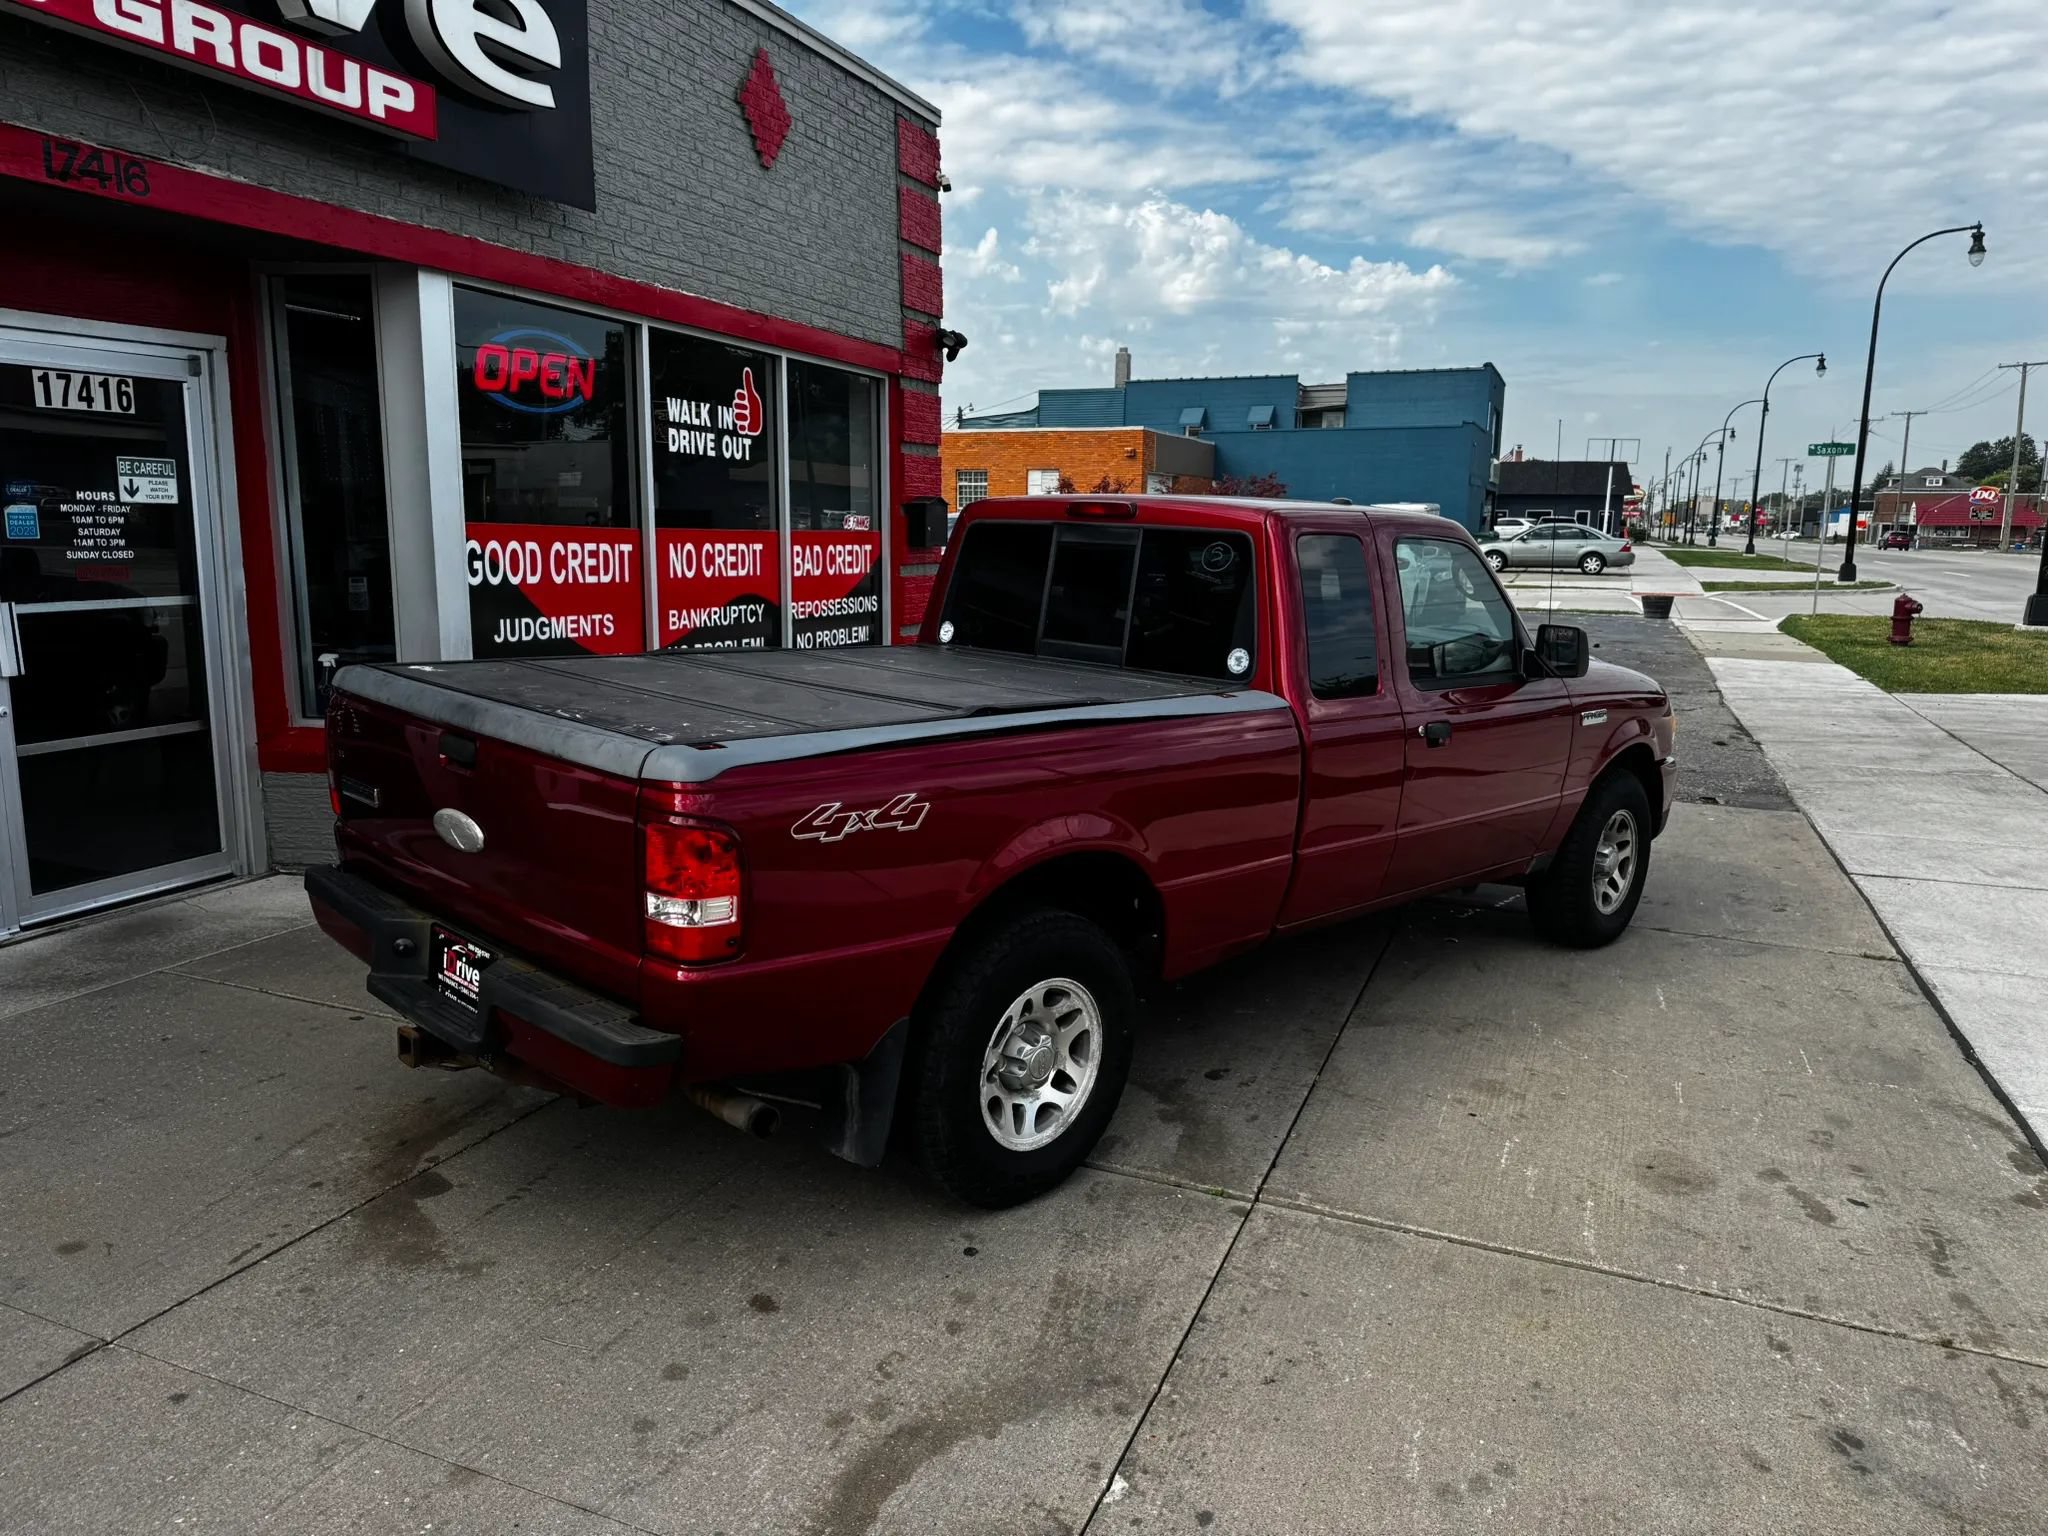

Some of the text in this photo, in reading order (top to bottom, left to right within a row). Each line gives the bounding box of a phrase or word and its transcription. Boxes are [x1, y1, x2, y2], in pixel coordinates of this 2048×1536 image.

[93, 0, 416, 119] GROUP
[42, 139, 151, 197] 17416
[474, 343, 597, 401] OPEN
[37, 371, 133, 413] 17416
[666, 396, 734, 431] WALK IN
[668, 427, 752, 461] DRIVE OUT
[1816, 445, 1849, 455] Saxony
[119, 461, 175, 476] BE CAREFUL
[60, 504, 96, 513] MONDAY
[102, 505, 131, 513] FRIDAY
[76, 490, 116, 501] HOURS
[1975, 490, 1996, 501] DQ
[10, 526, 36, 536] 2023
[71, 516, 125, 524] 10AM TO 6PM
[78, 528, 121, 536] SATURDAY
[66, 551, 135, 559] SUNDAY CLOSED
[73, 539, 126, 547] 11AM TO 3PM
[465, 539, 633, 586] GOOD CREDIT
[669, 542, 763, 579] NO CREDIT
[793, 544, 872, 577] BAD CREDIT
[668, 603, 765, 630] BANKRUPTCY
[791, 595, 878, 620] REPOSSESSIONS
[493, 613, 615, 644] JUDGMENTS
[796, 625, 869, 649] NO PROBLEM!
[790, 792, 930, 843] 4x4
[443, 946, 480, 987] iDrive
